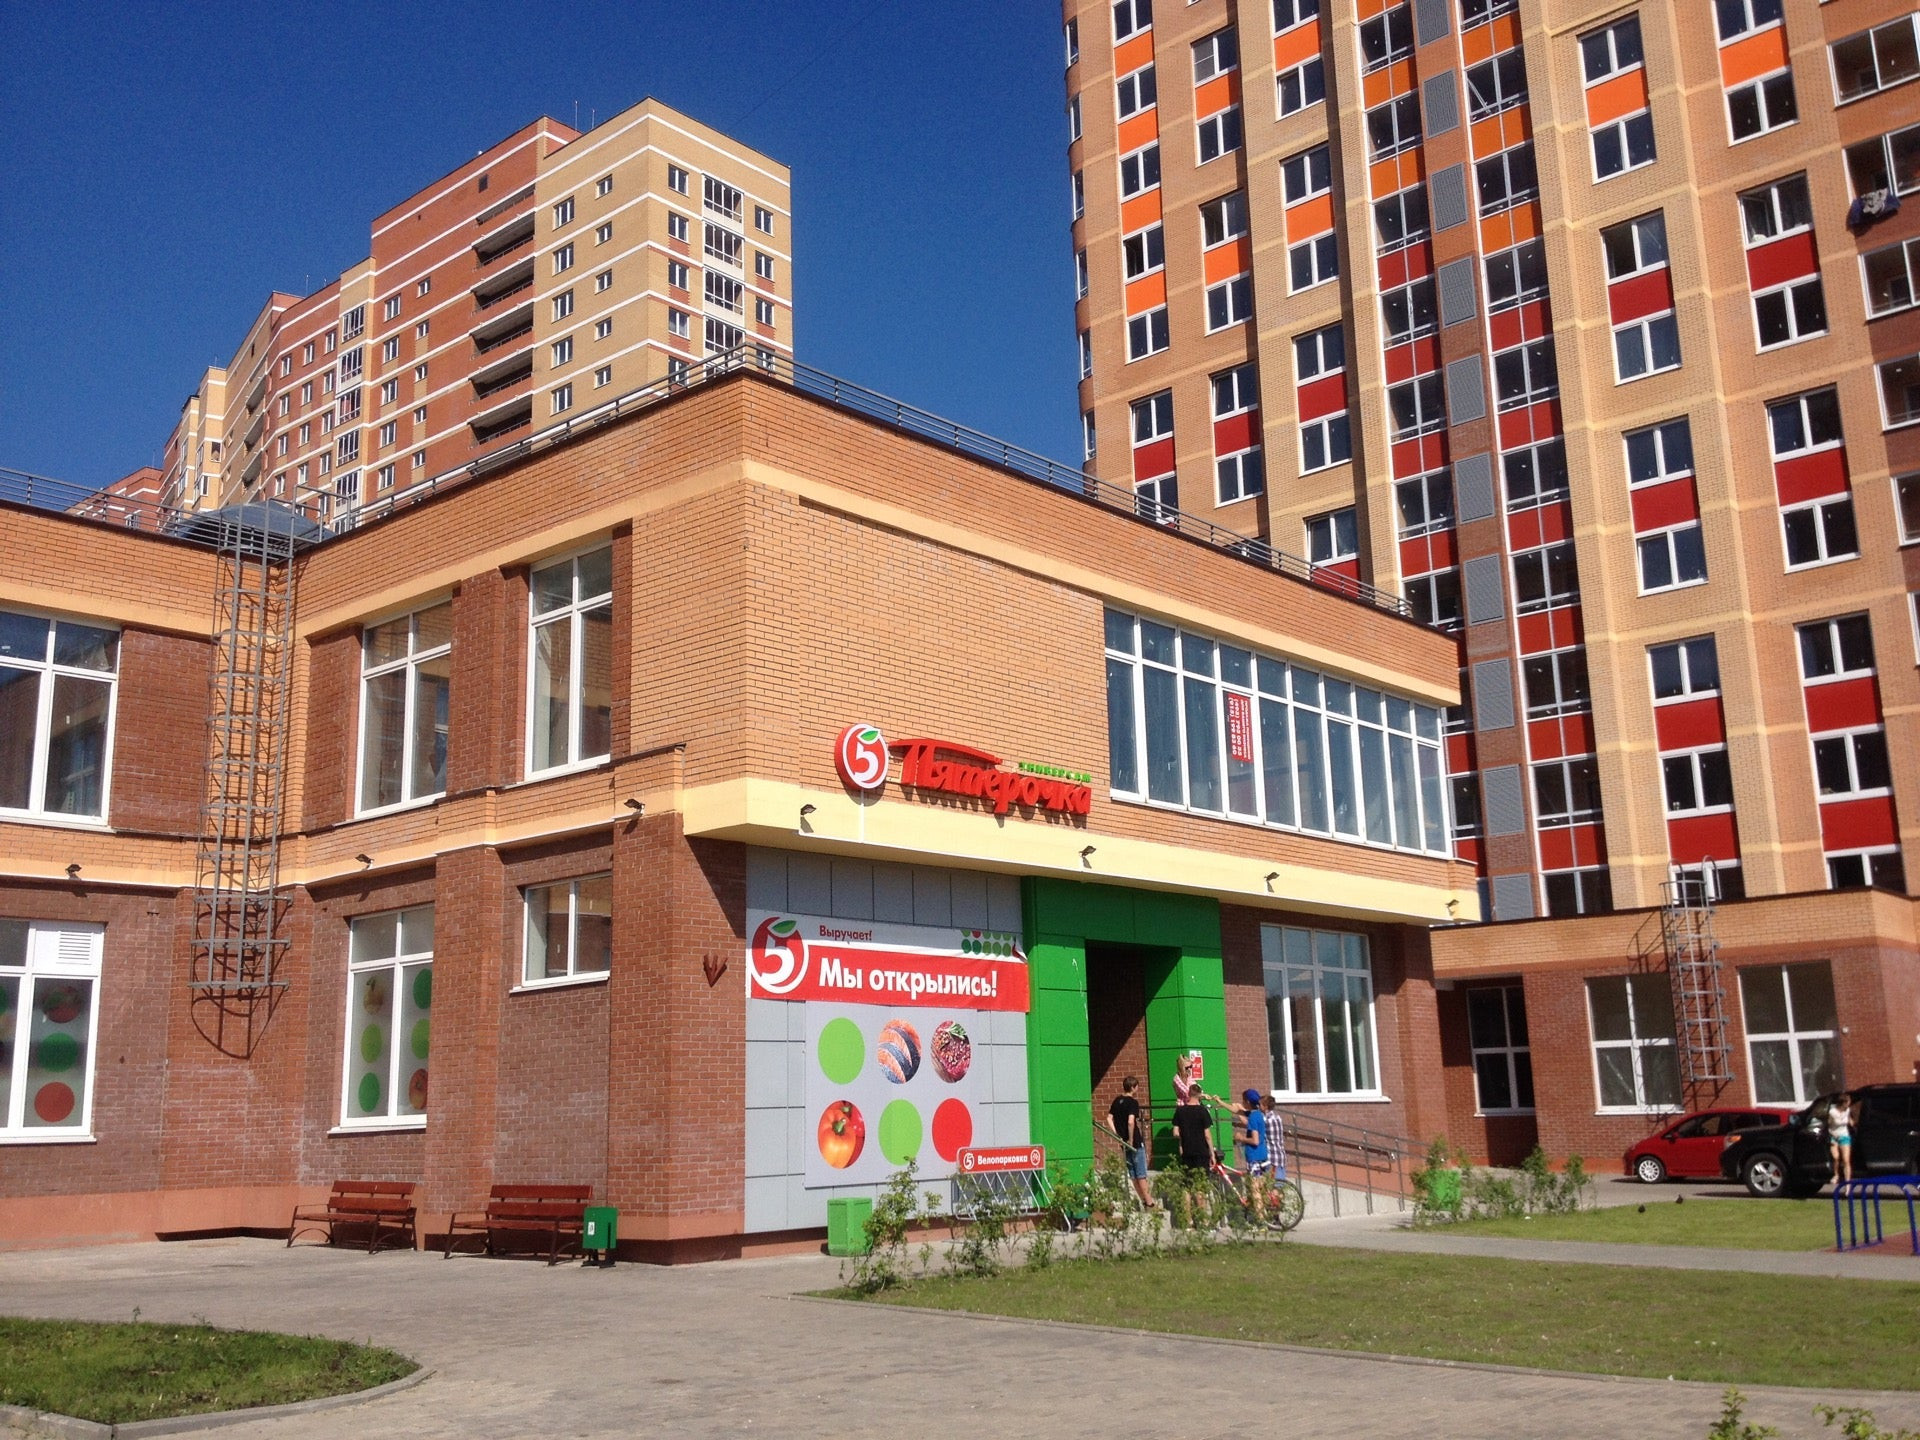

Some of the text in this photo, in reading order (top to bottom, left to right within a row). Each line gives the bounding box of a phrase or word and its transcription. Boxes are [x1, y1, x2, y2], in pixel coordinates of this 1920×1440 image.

[819, 925, 873, 941] Выручает!
[819, 957, 998, 1000] Мы открылись!
[977, 1155, 1028, 1166] Велопарковка
